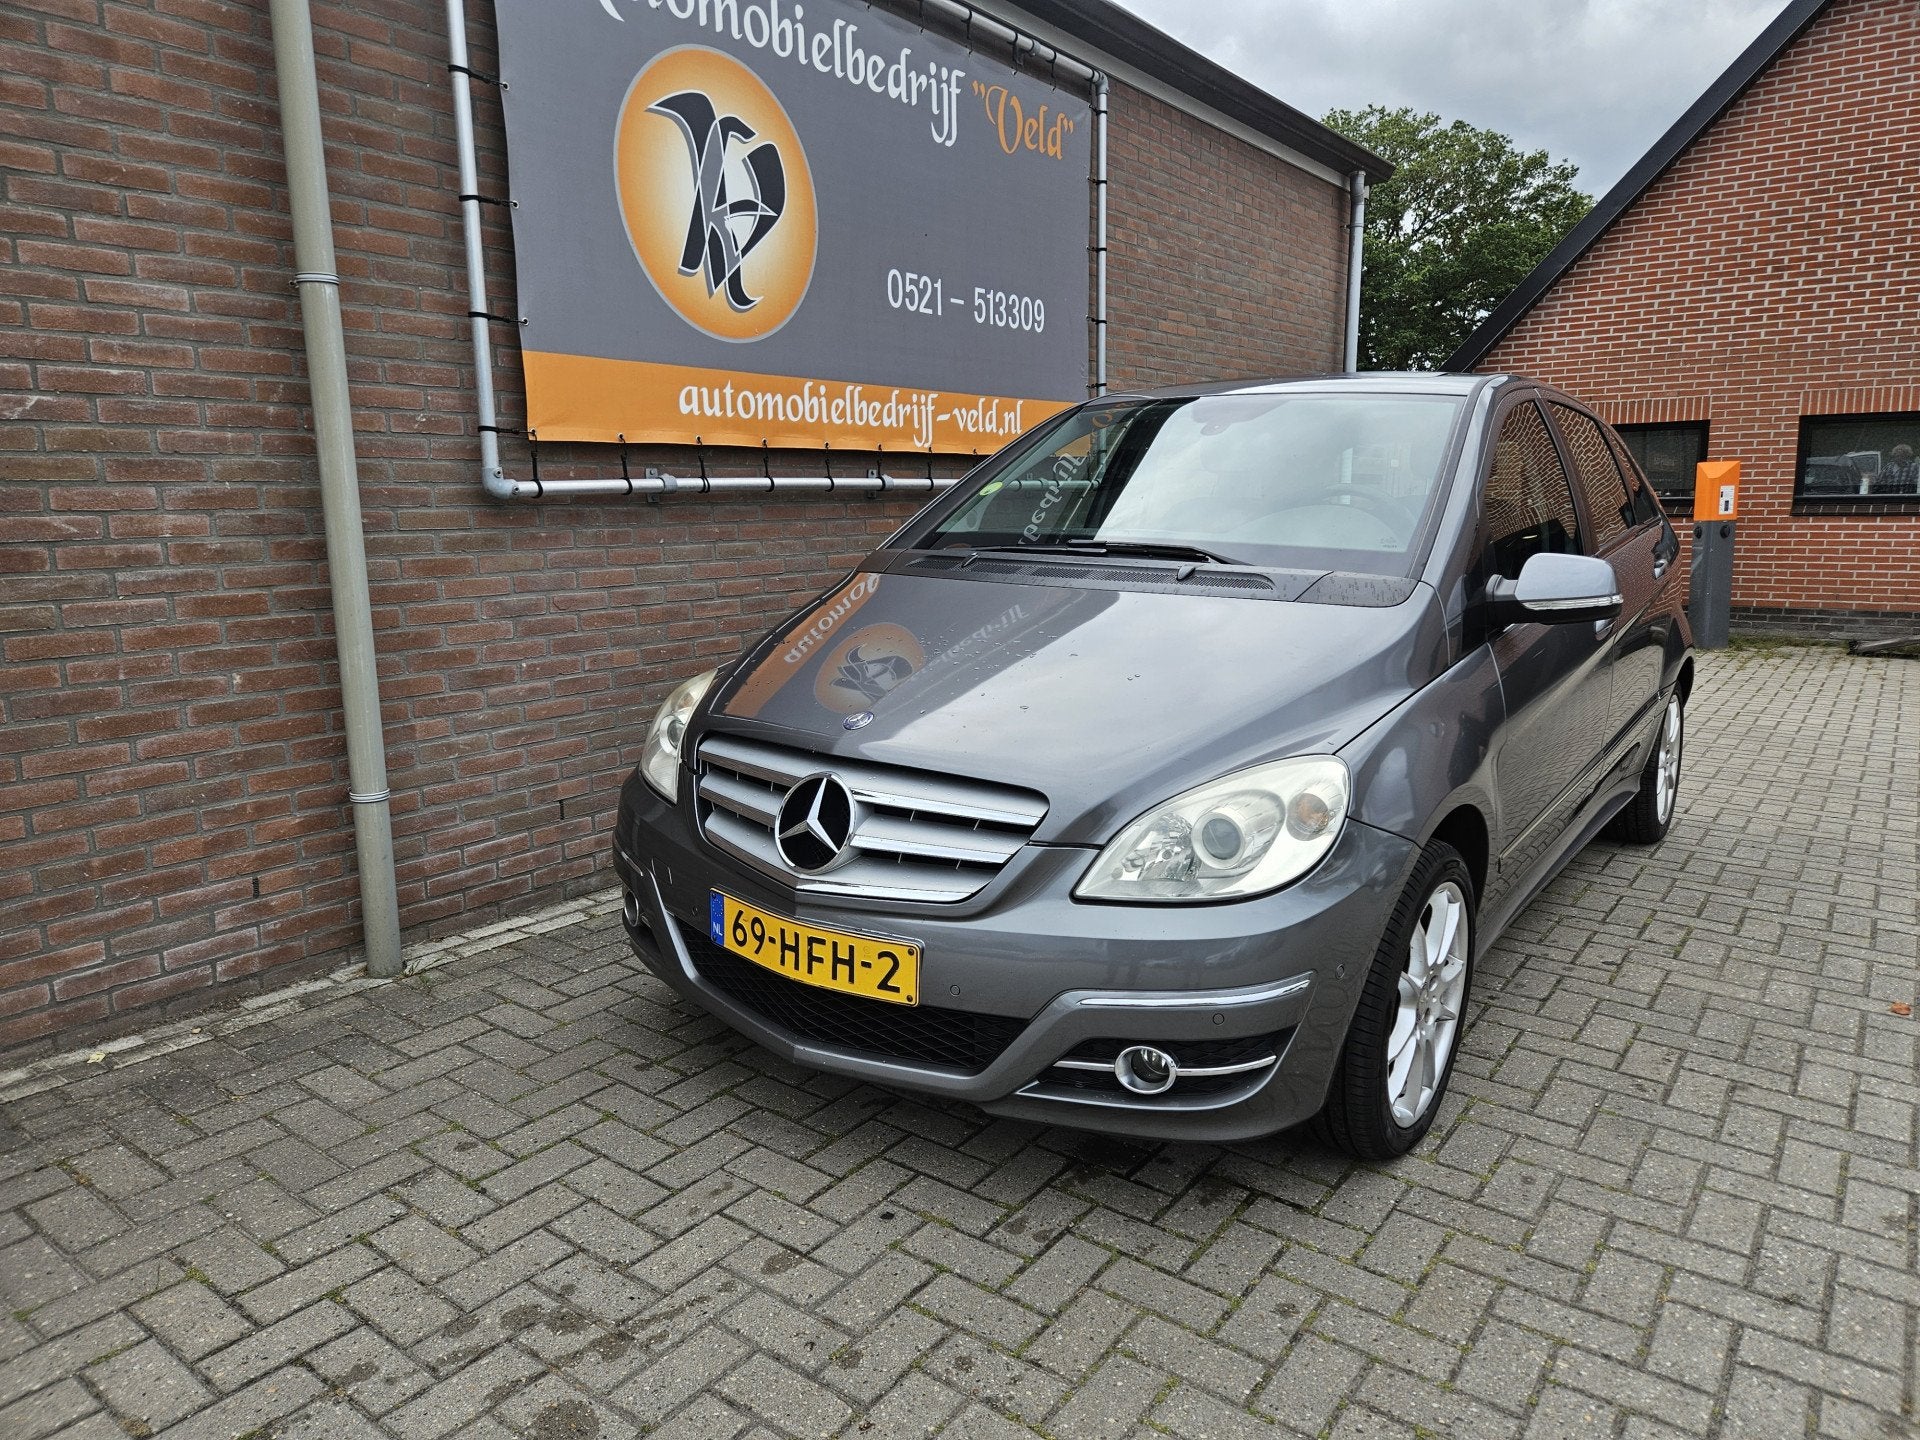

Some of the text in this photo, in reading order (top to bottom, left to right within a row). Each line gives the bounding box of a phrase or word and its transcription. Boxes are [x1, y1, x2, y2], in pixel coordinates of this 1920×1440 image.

[887, 268, 942, 316] 0521
[973, 286, 1045, 333] 513309
[679, 380, 1023, 447] automobielbedrijf-veld.nl
[712, 921, 723, 937] NL
[732, 909, 901, 994] 69-HFH-2
